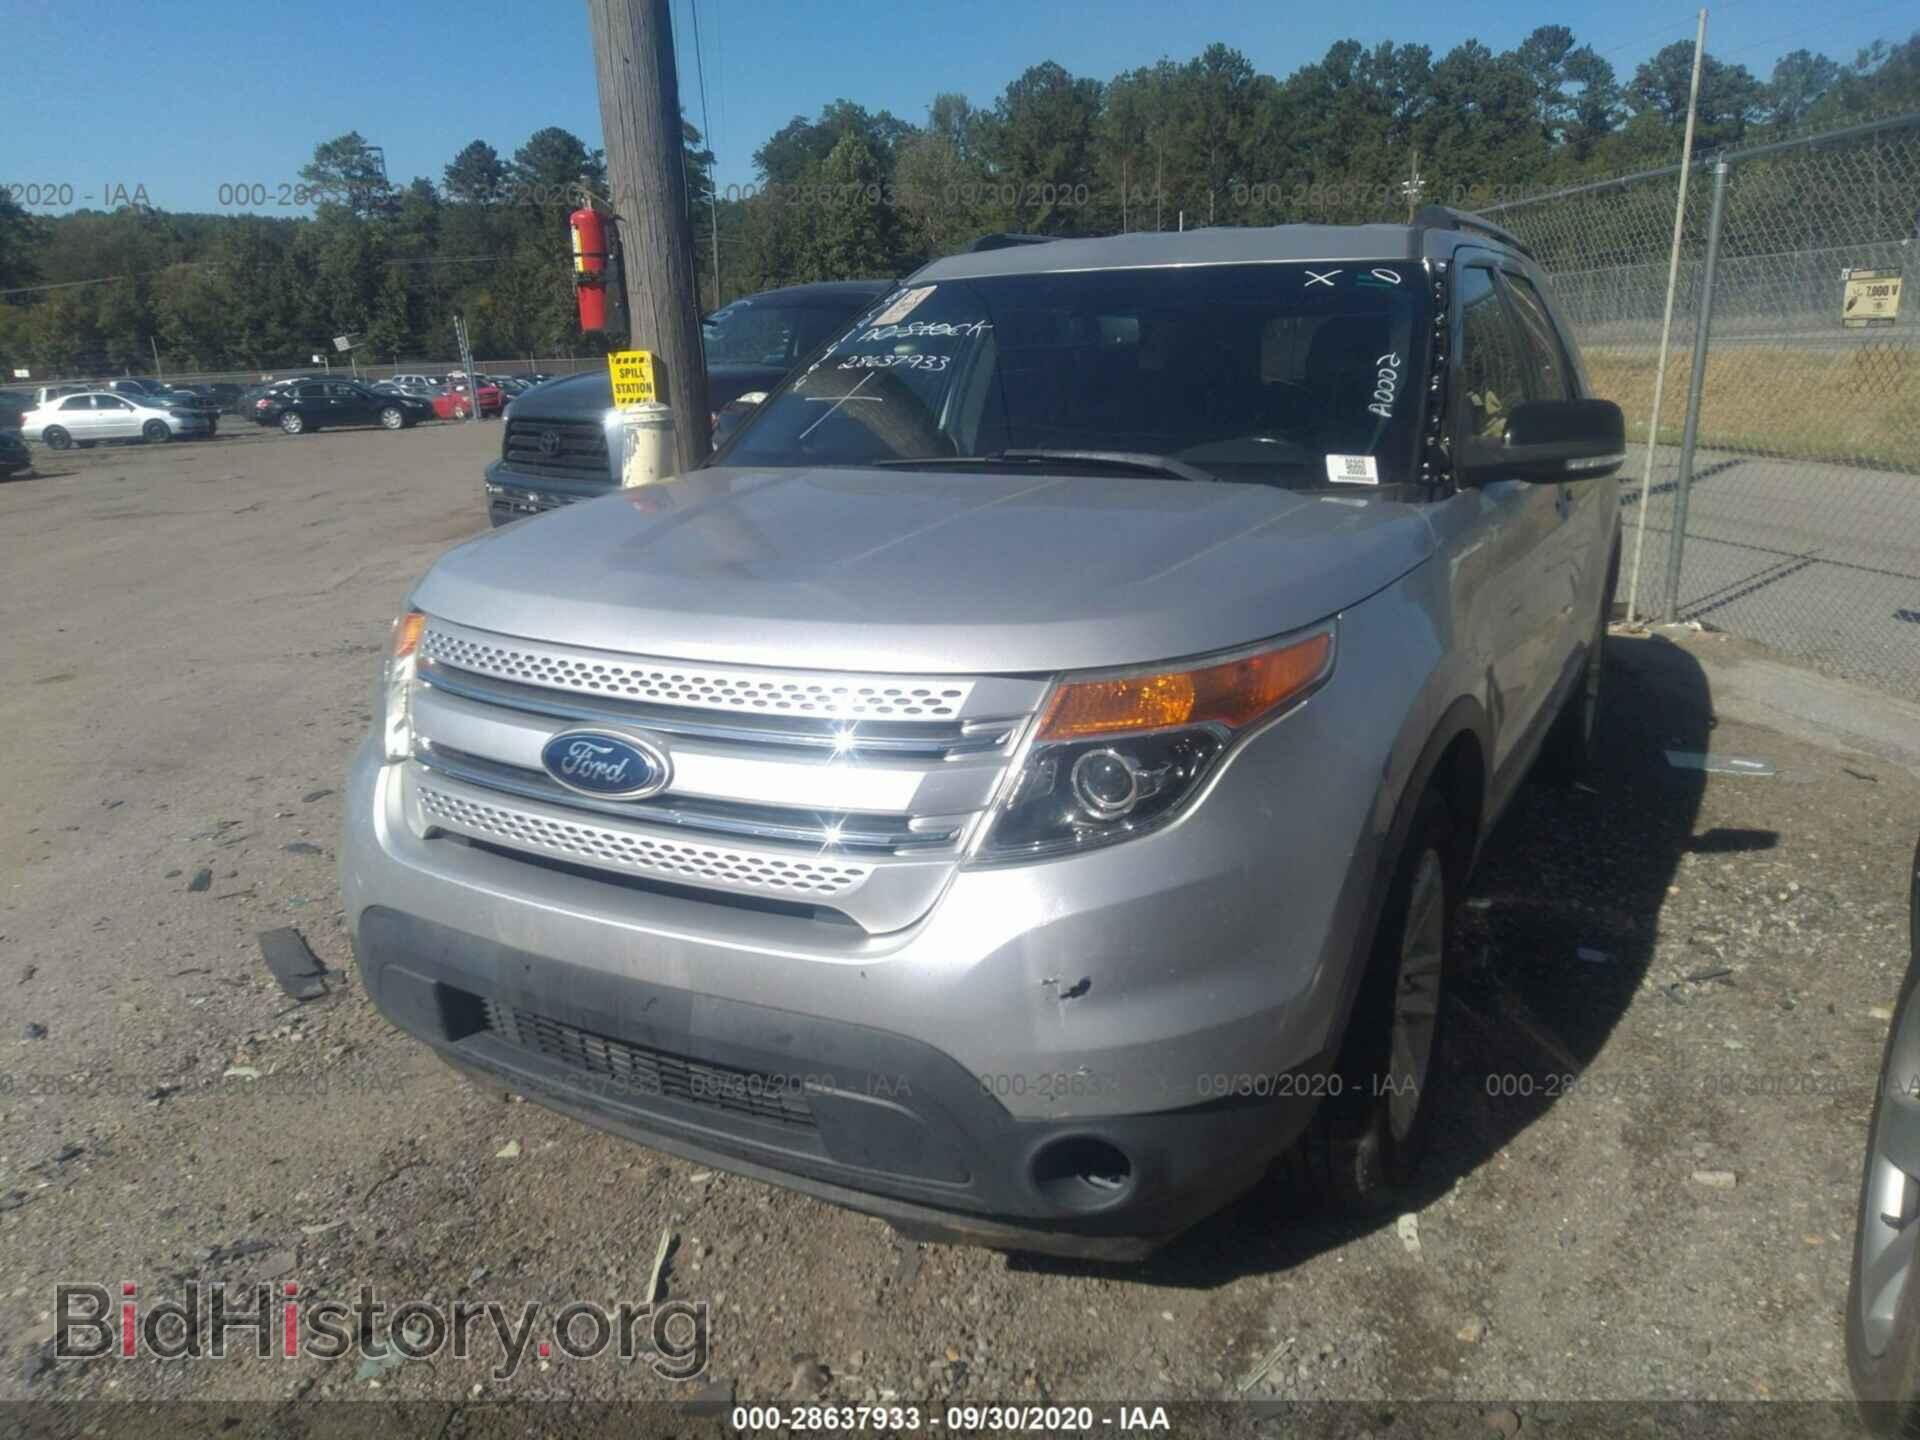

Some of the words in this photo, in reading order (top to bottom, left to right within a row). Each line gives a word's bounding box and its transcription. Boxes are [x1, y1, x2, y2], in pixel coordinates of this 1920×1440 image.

[619, 367, 645, 379] SPILL
[615, 382, 653, 394] STATION
[561, 741, 631, 784] Ford
